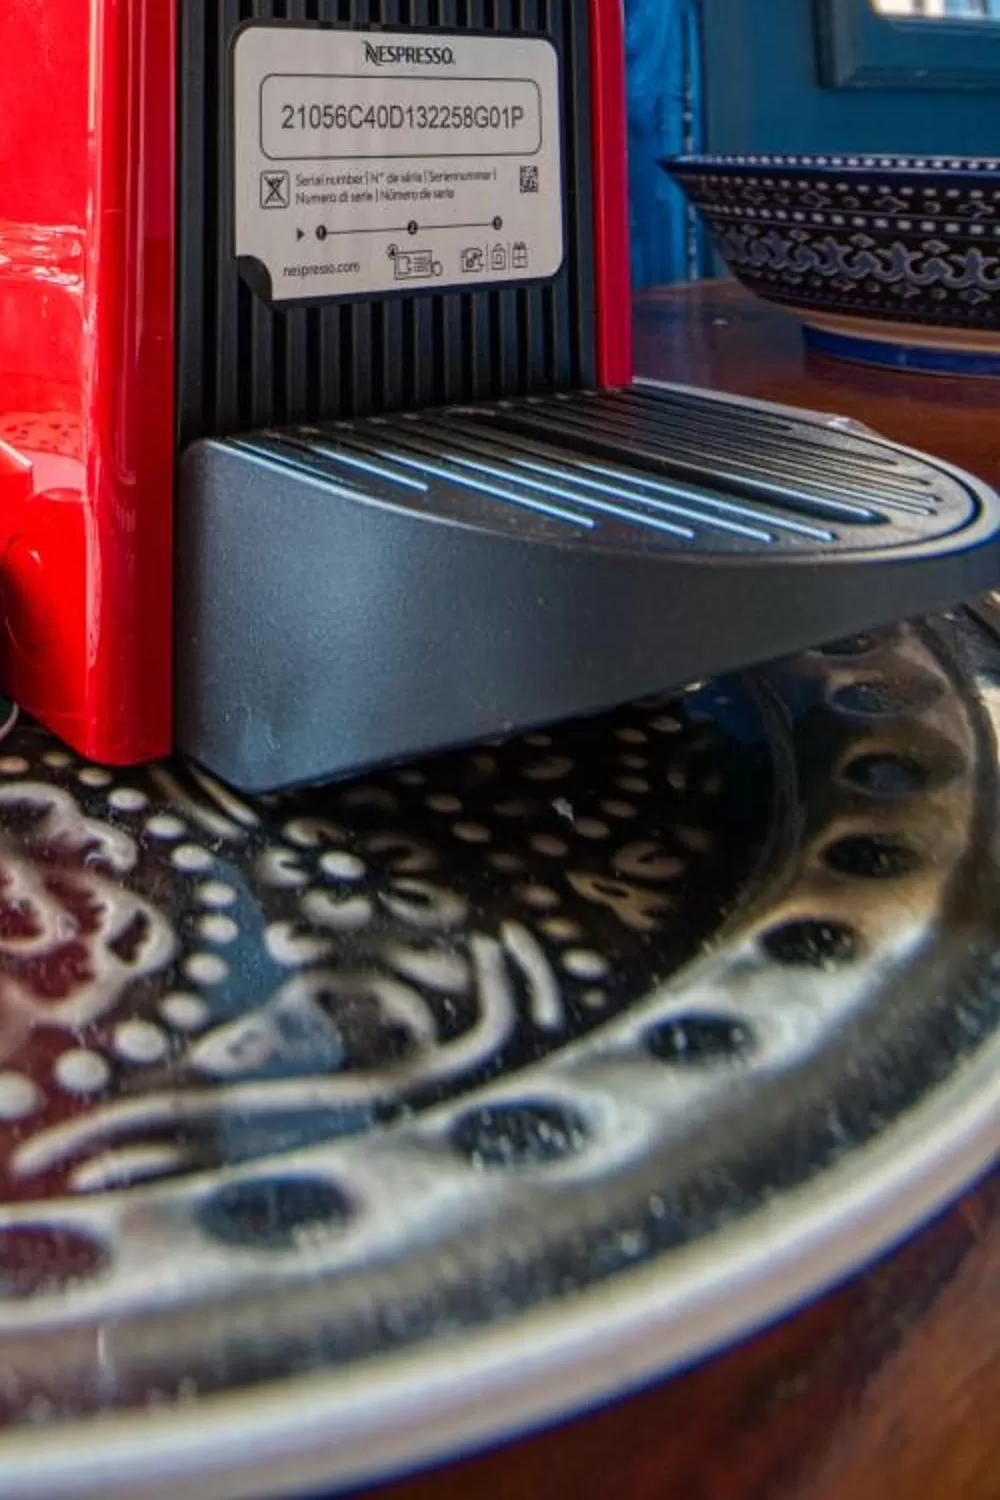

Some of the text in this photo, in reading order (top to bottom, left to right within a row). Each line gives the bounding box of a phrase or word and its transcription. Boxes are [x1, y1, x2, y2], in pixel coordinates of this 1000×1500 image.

[363, 40, 455, 66] NESPRESSO
[281, 104, 524, 130] 21056C40D132258G01P
[295, 172, 325, 187] Serial
[325, 171, 363, 186] number
[386, 172, 399, 184] de
[295, 191, 337, 204] Numero
[339, 190, 349, 204] di
[419, 187, 431, 200] de
[283, 261, 361, 278] nespresso.com
